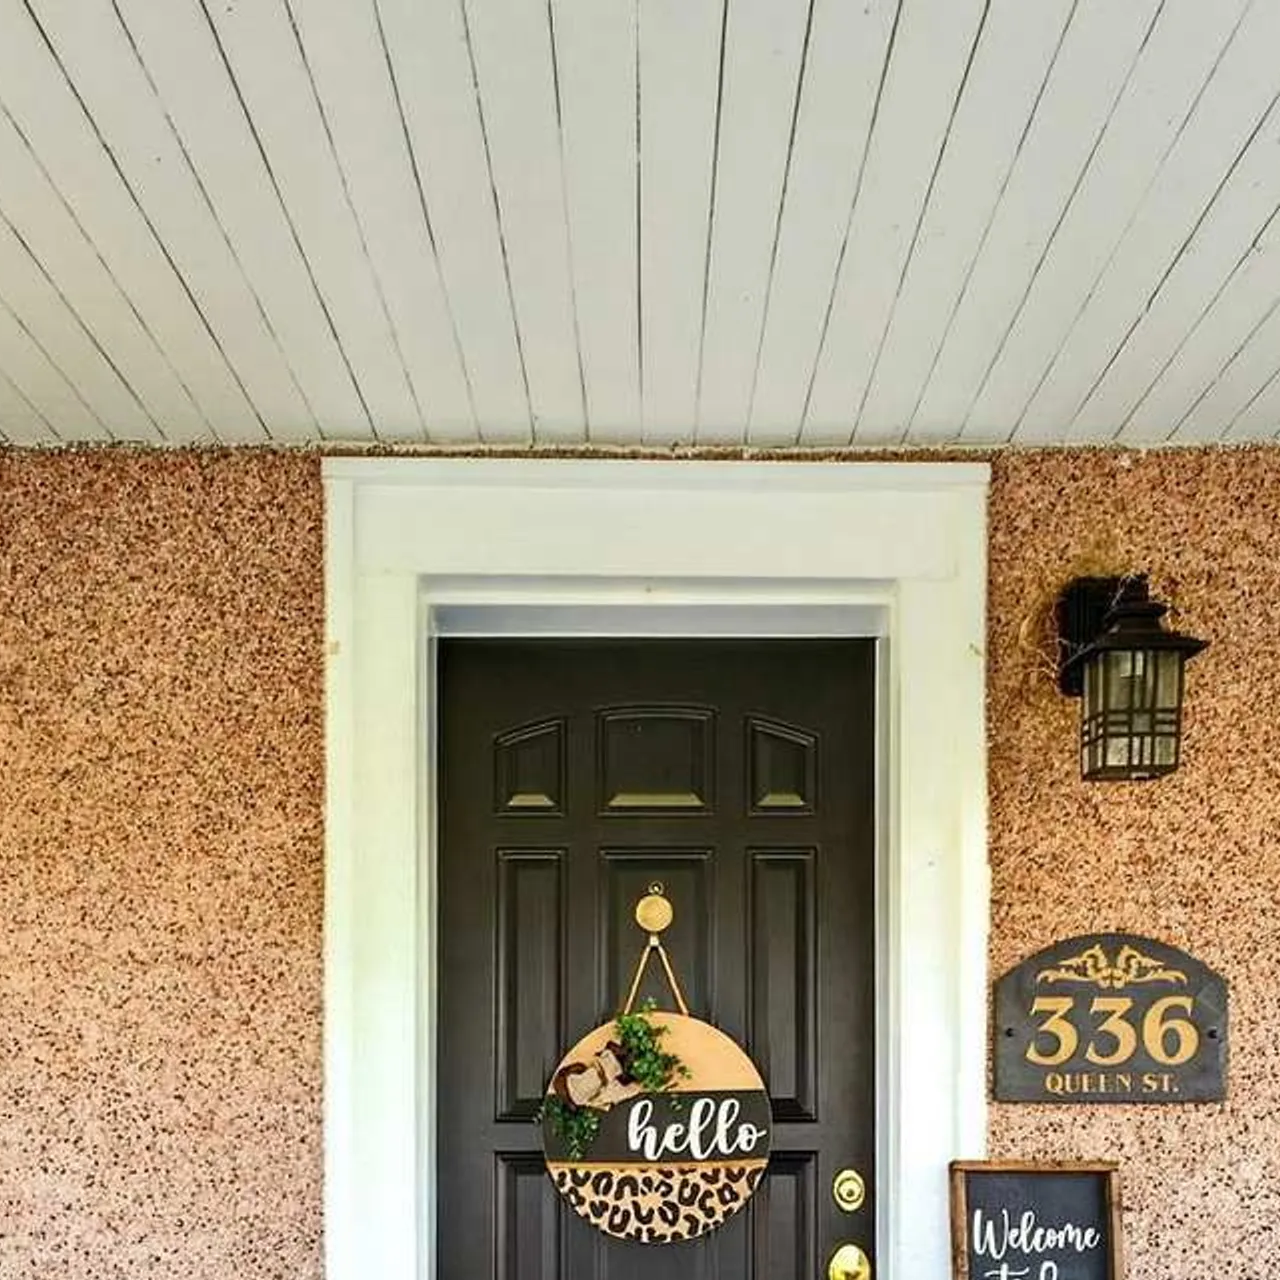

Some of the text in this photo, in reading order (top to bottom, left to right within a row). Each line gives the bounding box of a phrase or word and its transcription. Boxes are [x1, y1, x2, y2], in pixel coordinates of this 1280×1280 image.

[1024, 995, 1200, 1066] 336
[1044, 1071, 1180, 1095] QUEEN ST.
[627, 1097, 767, 1160] hello
[973, 1208, 1101, 1260] Welcome
